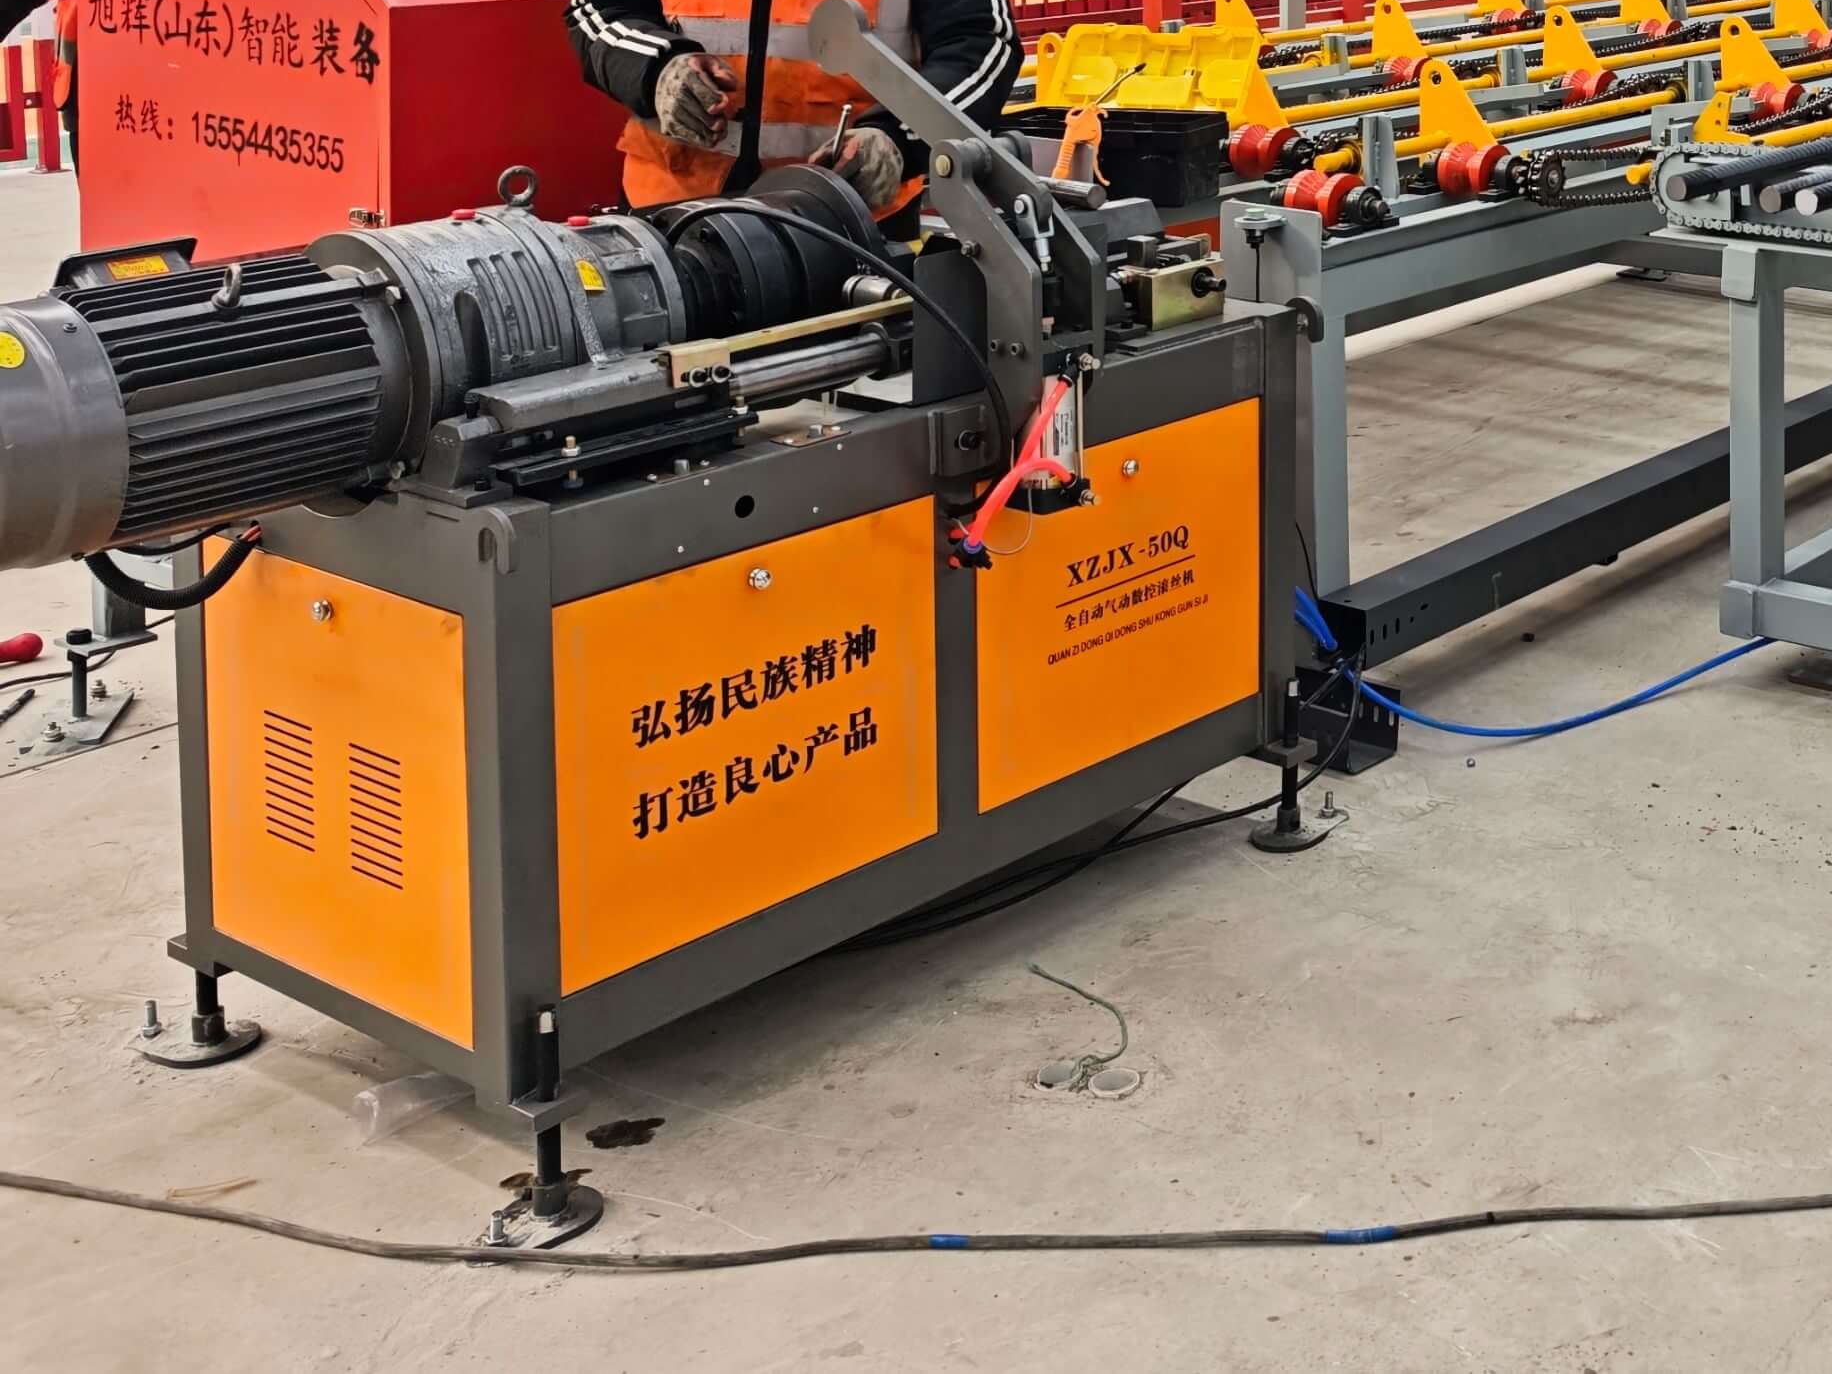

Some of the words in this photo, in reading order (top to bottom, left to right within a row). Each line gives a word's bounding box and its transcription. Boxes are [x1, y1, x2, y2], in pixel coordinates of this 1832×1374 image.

[631, 623, 879, 750] 弘扬民族精神
[1047, 649, 1072, 666] QUAN
[1081, 635, 1104, 653] DONG
[1115, 621, 1137, 640] DONG
[1138, 615, 1154, 630] SHU
[1155, 606, 1176, 625] KONG
[1177, 600, 1193, 615] GUN
[631, 705, 879, 839] 打造良心产品
